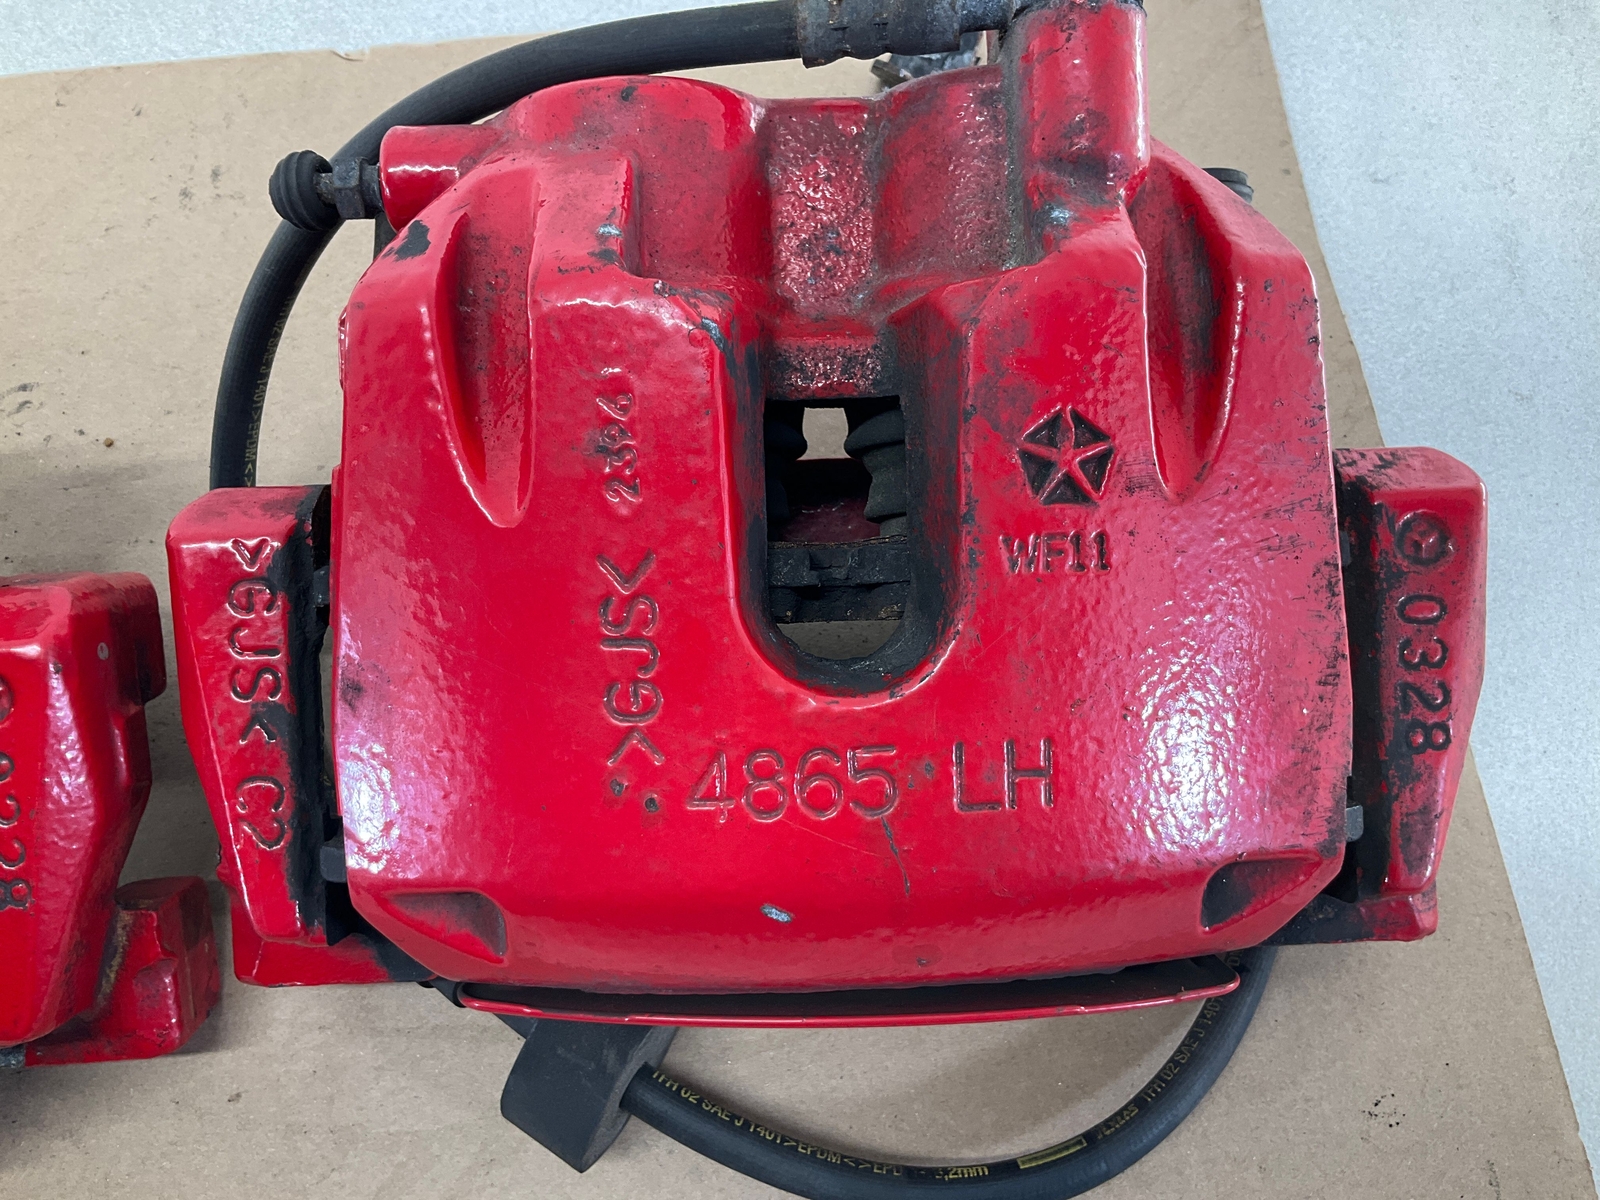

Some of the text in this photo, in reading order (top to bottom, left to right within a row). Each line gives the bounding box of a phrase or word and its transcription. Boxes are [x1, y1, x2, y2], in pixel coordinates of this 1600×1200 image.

[999, 529, 1112, 576] WF11
[1396, 592, 1453, 756] 0328
[685, 737, 1055, 823] 4865 LH
[234, 774, 288, 851] C2
[1173, 1036, 1199, 1064] SAE
[701, 1099, 732, 1121] SAE
